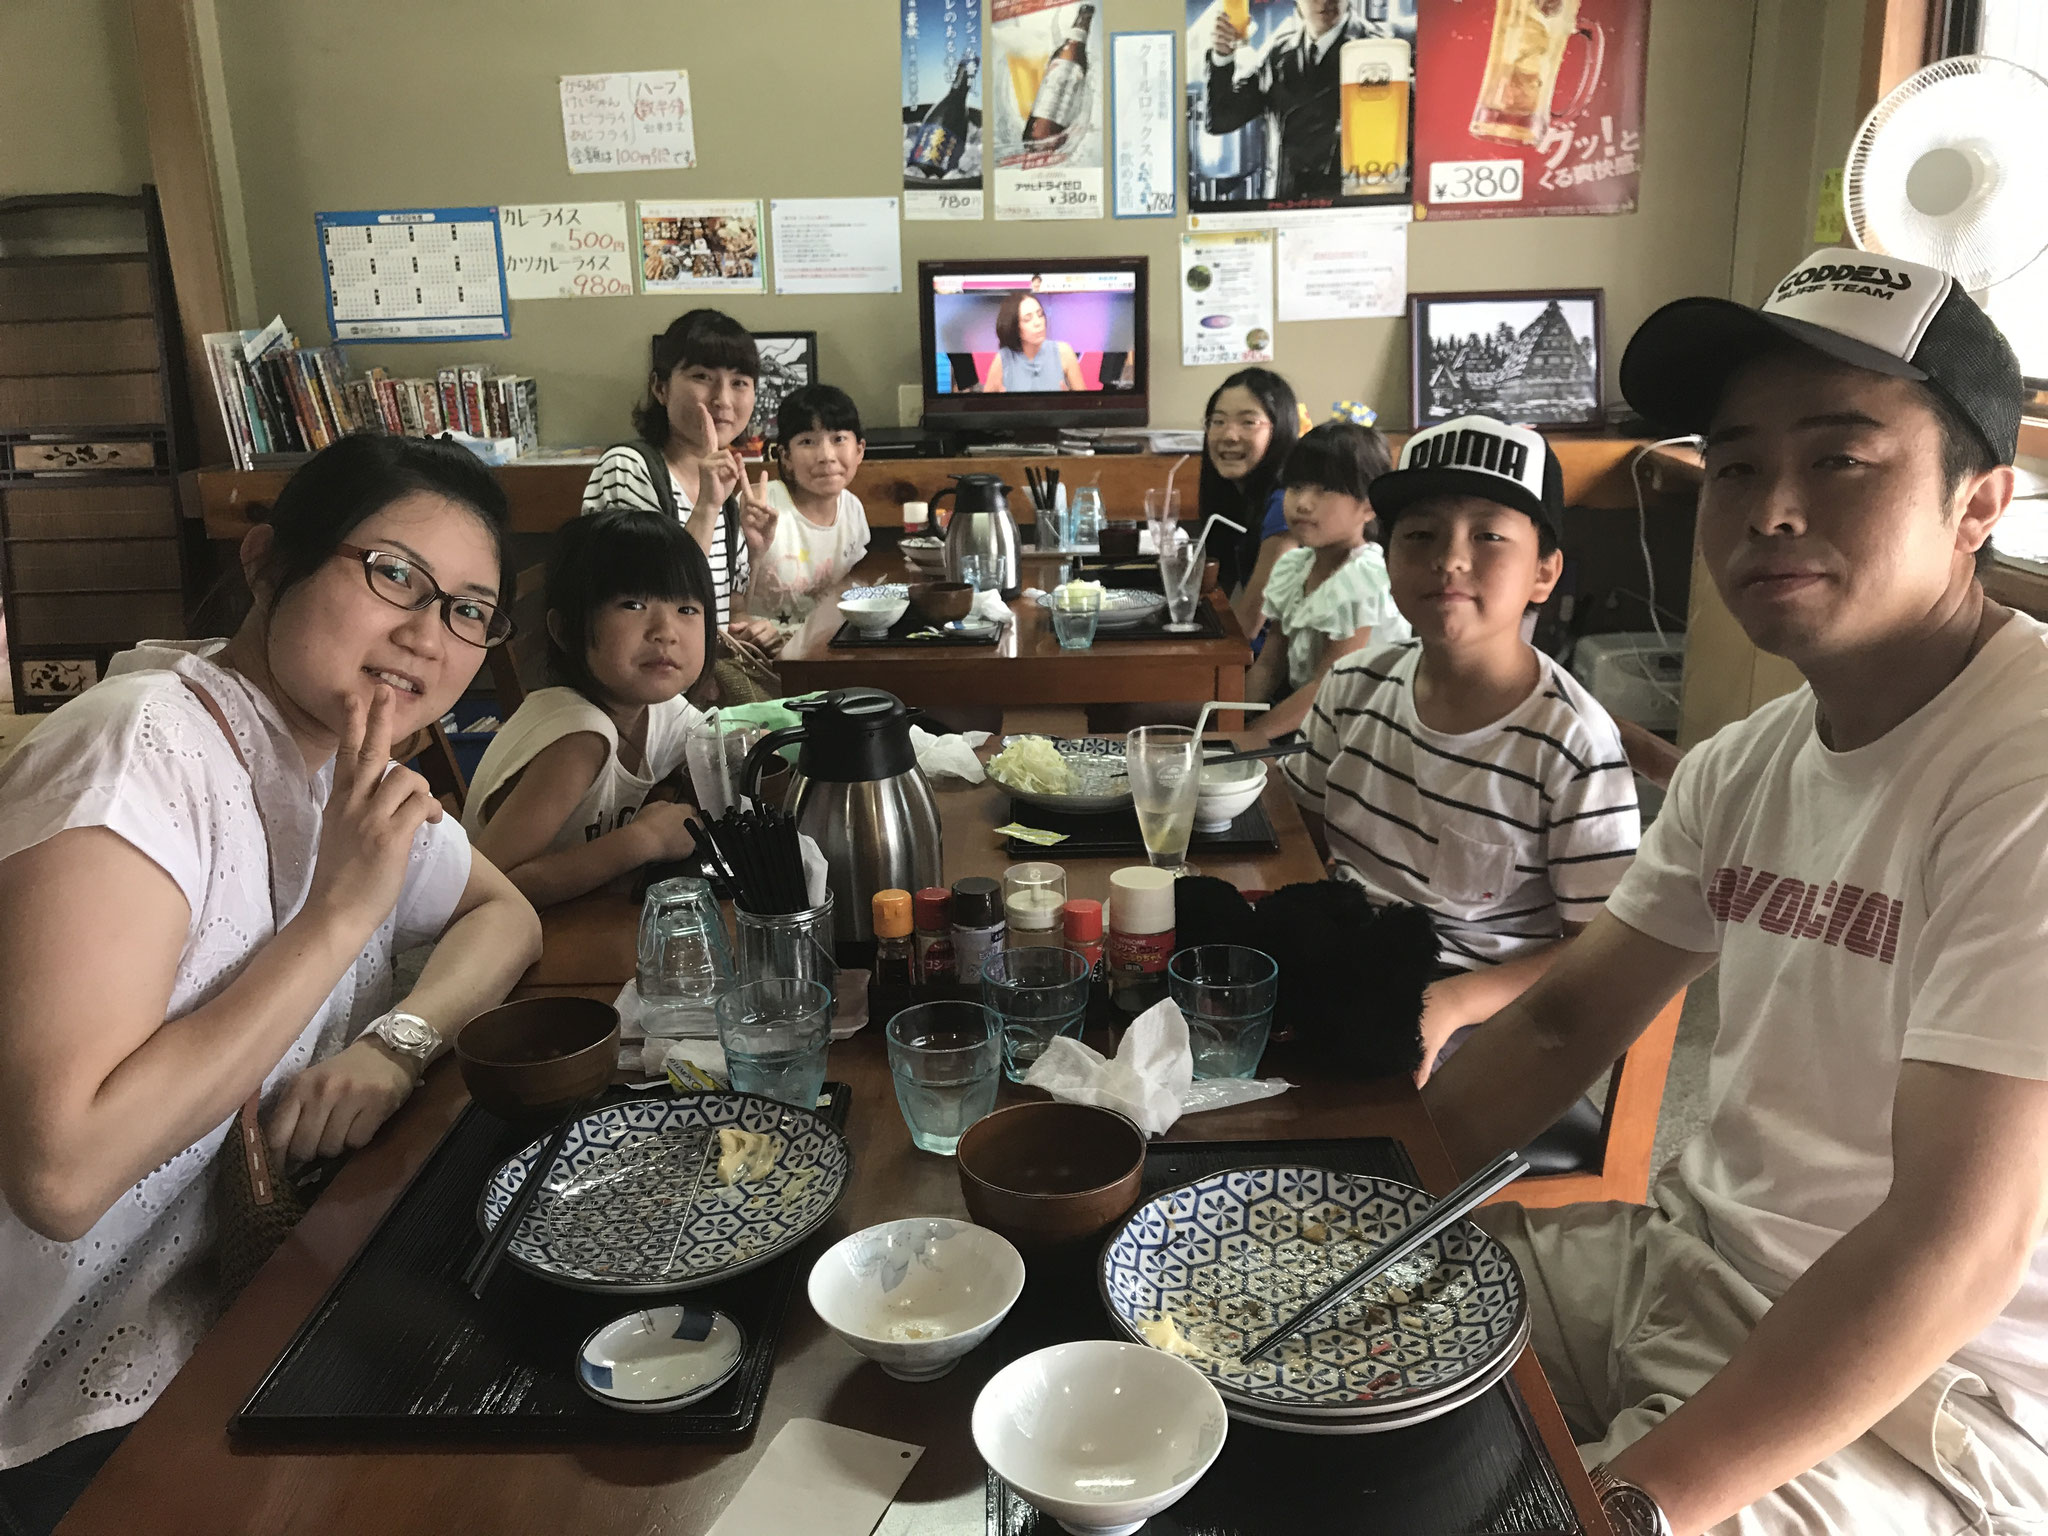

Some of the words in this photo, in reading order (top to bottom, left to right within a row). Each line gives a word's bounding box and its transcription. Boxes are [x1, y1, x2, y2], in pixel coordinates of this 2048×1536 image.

[504, 208, 582, 228] カレーライス
[569, 228, 625, 252] 500円
[506, 255, 610, 274] カツカレーライス
[573, 274, 631, 296] 980円
[1778, 264, 1912, 293] GODDESS
[1776, 283, 1827, 303] SURF
[1831, 283, 1895, 301] TEAM
[1408, 429, 1529, 482] PUMA
